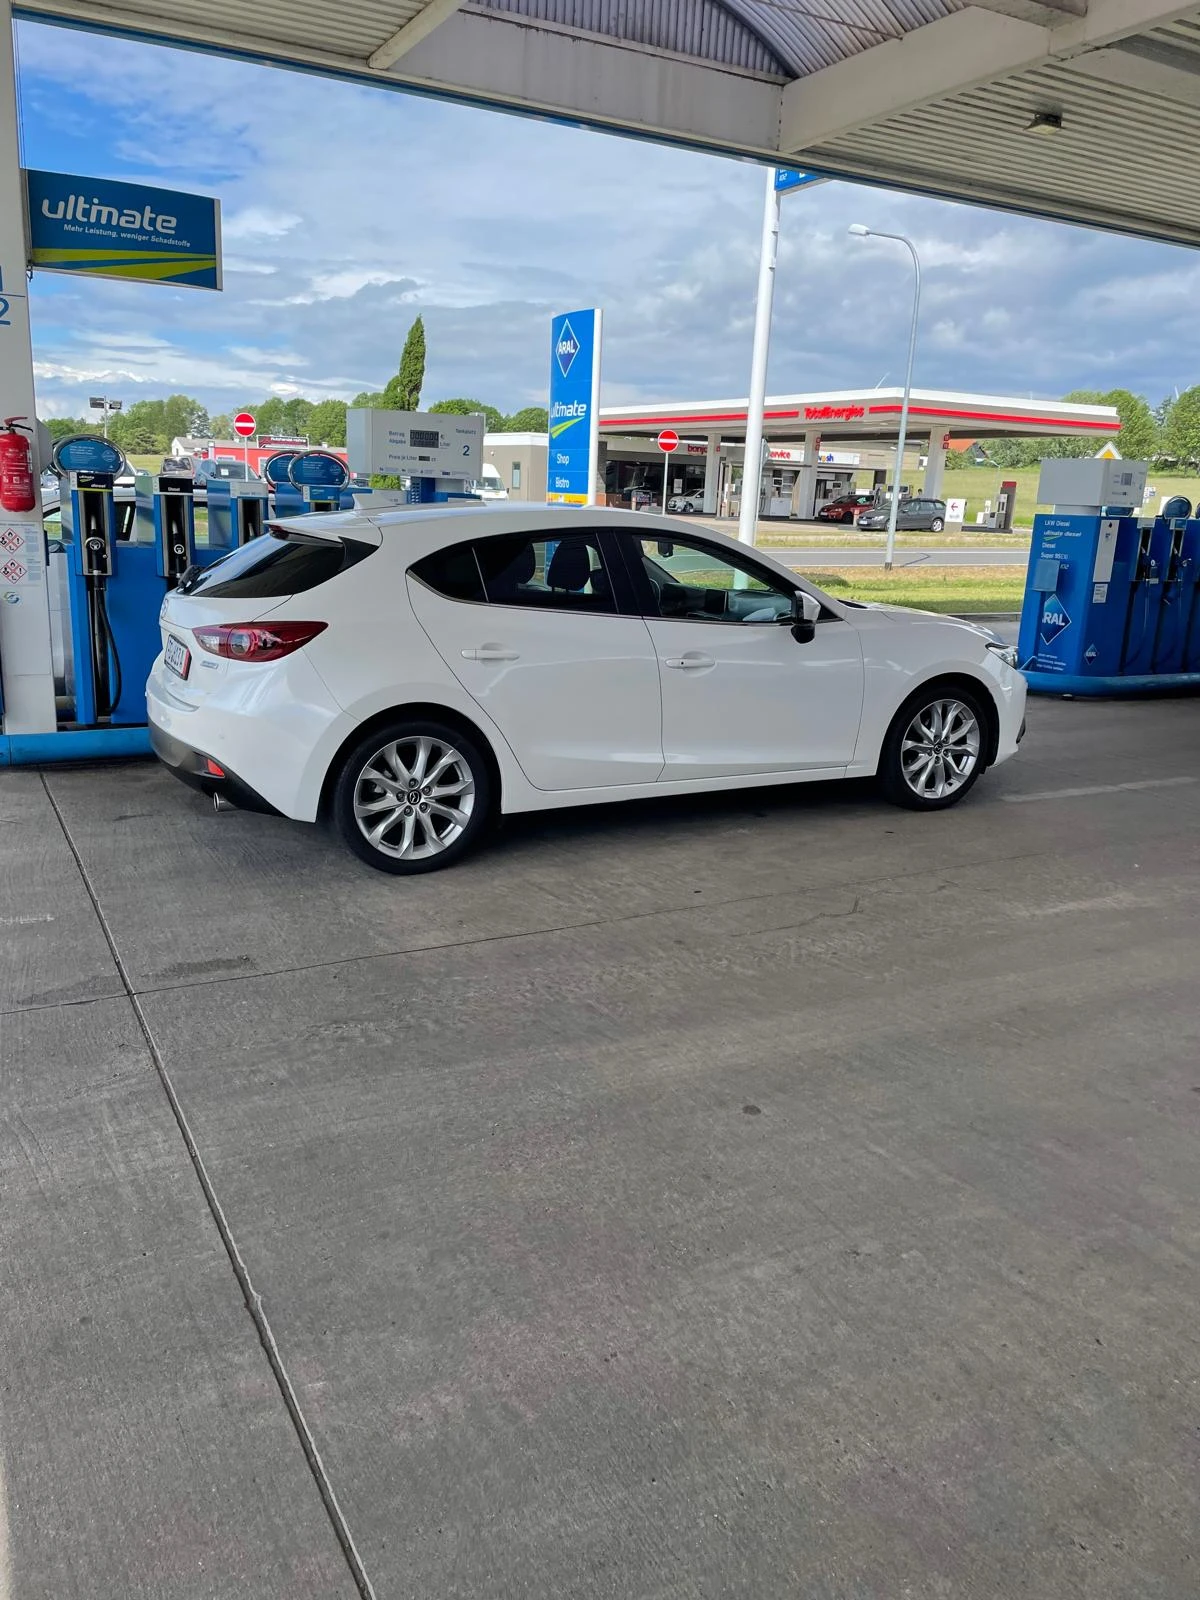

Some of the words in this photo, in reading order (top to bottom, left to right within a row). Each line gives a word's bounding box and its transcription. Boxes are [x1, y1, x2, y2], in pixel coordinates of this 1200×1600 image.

[42, 194, 177, 235] ultimate
[63, 223, 83, 233] Mehr
[85, 226, 118, 238] Leistung,
[120, 232, 149, 242] weniger
[150, 235, 191, 248] Schadstoffe
[558, 339, 575, 354] ARAL
[550, 400, 587, 418] ultimate
[804, 405, 865, 421] TotalEnergies
[462, 445, 470, 456] 2
[769, 451, 791, 459] ervice
[556, 453, 570, 465] Shop
[555, 476, 570, 489] Bistro
[1042, 611, 1066, 626] RAL
